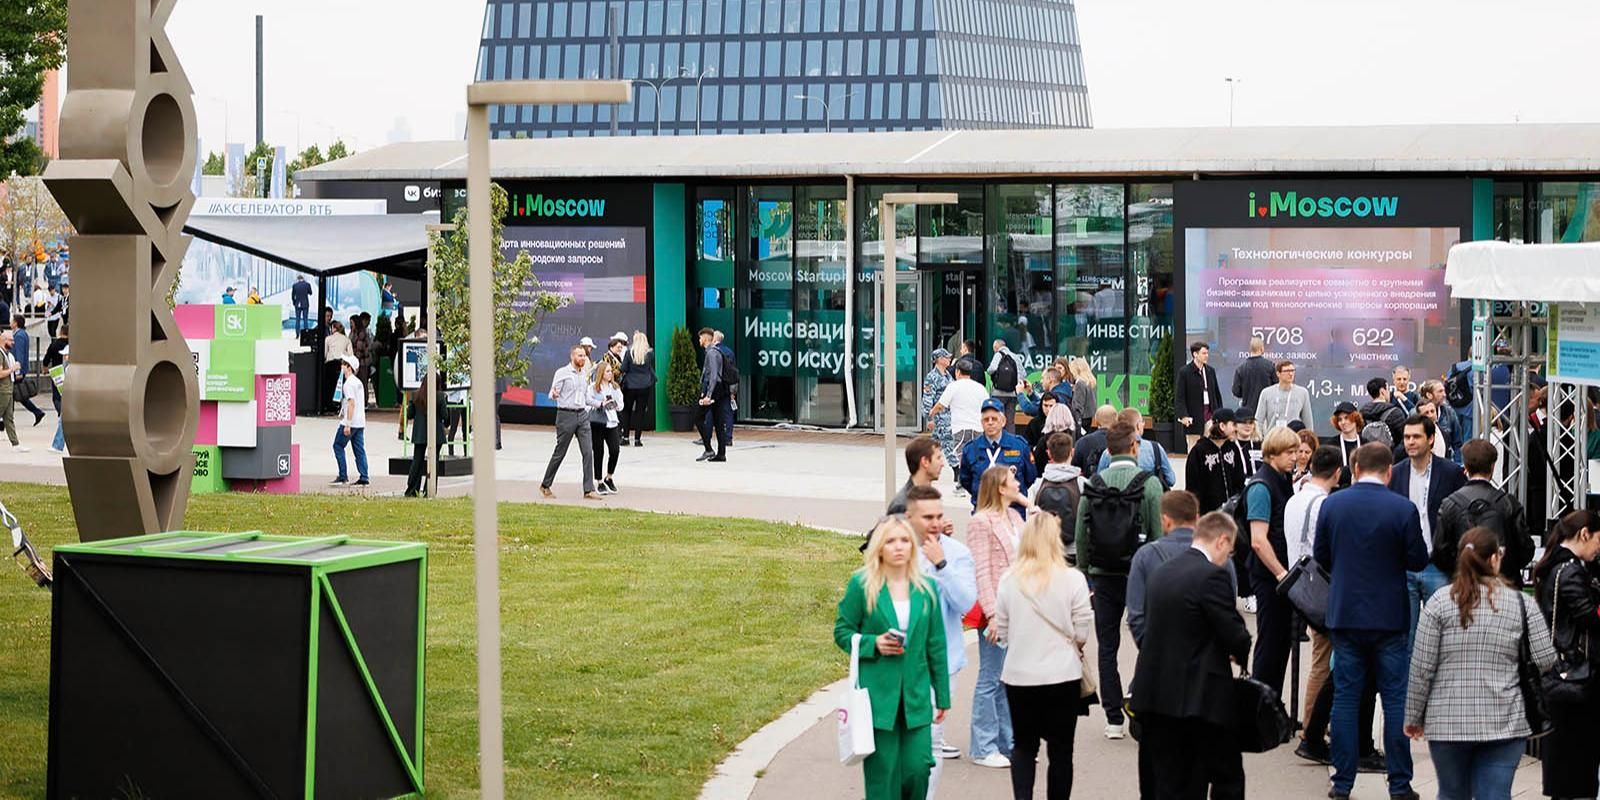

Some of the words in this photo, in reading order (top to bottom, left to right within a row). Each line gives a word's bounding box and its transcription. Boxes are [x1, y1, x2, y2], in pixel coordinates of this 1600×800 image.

[309, 204, 332, 217] ВТБ
[500, 239, 519, 251] арта
[520, 239, 586, 250] инновационных
[588, 238, 626, 251] решений
[567, 255, 604, 266] запросы
[1231, 247, 1343, 260] Технологические
[1349, 249, 1412, 263] конкурсы
[749, 269, 792, 282] Moscow
[1218, 277, 1267, 287] Программа
[1253, 301, 1268, 309] под
[1384, 302, 1438, 312] корпорации
[226, 314, 242, 330] Sk
[745, 316, 853, 344] Инноваци
[1252, 327, 1304, 345] 5708
[1352, 328, 1394, 346] 622
[758, 350, 792, 367] это
[1286, 352, 1318, 360] заявок
[1349, 353, 1400, 362] участника
[1307, 379, 1344, 398] 1,3+
